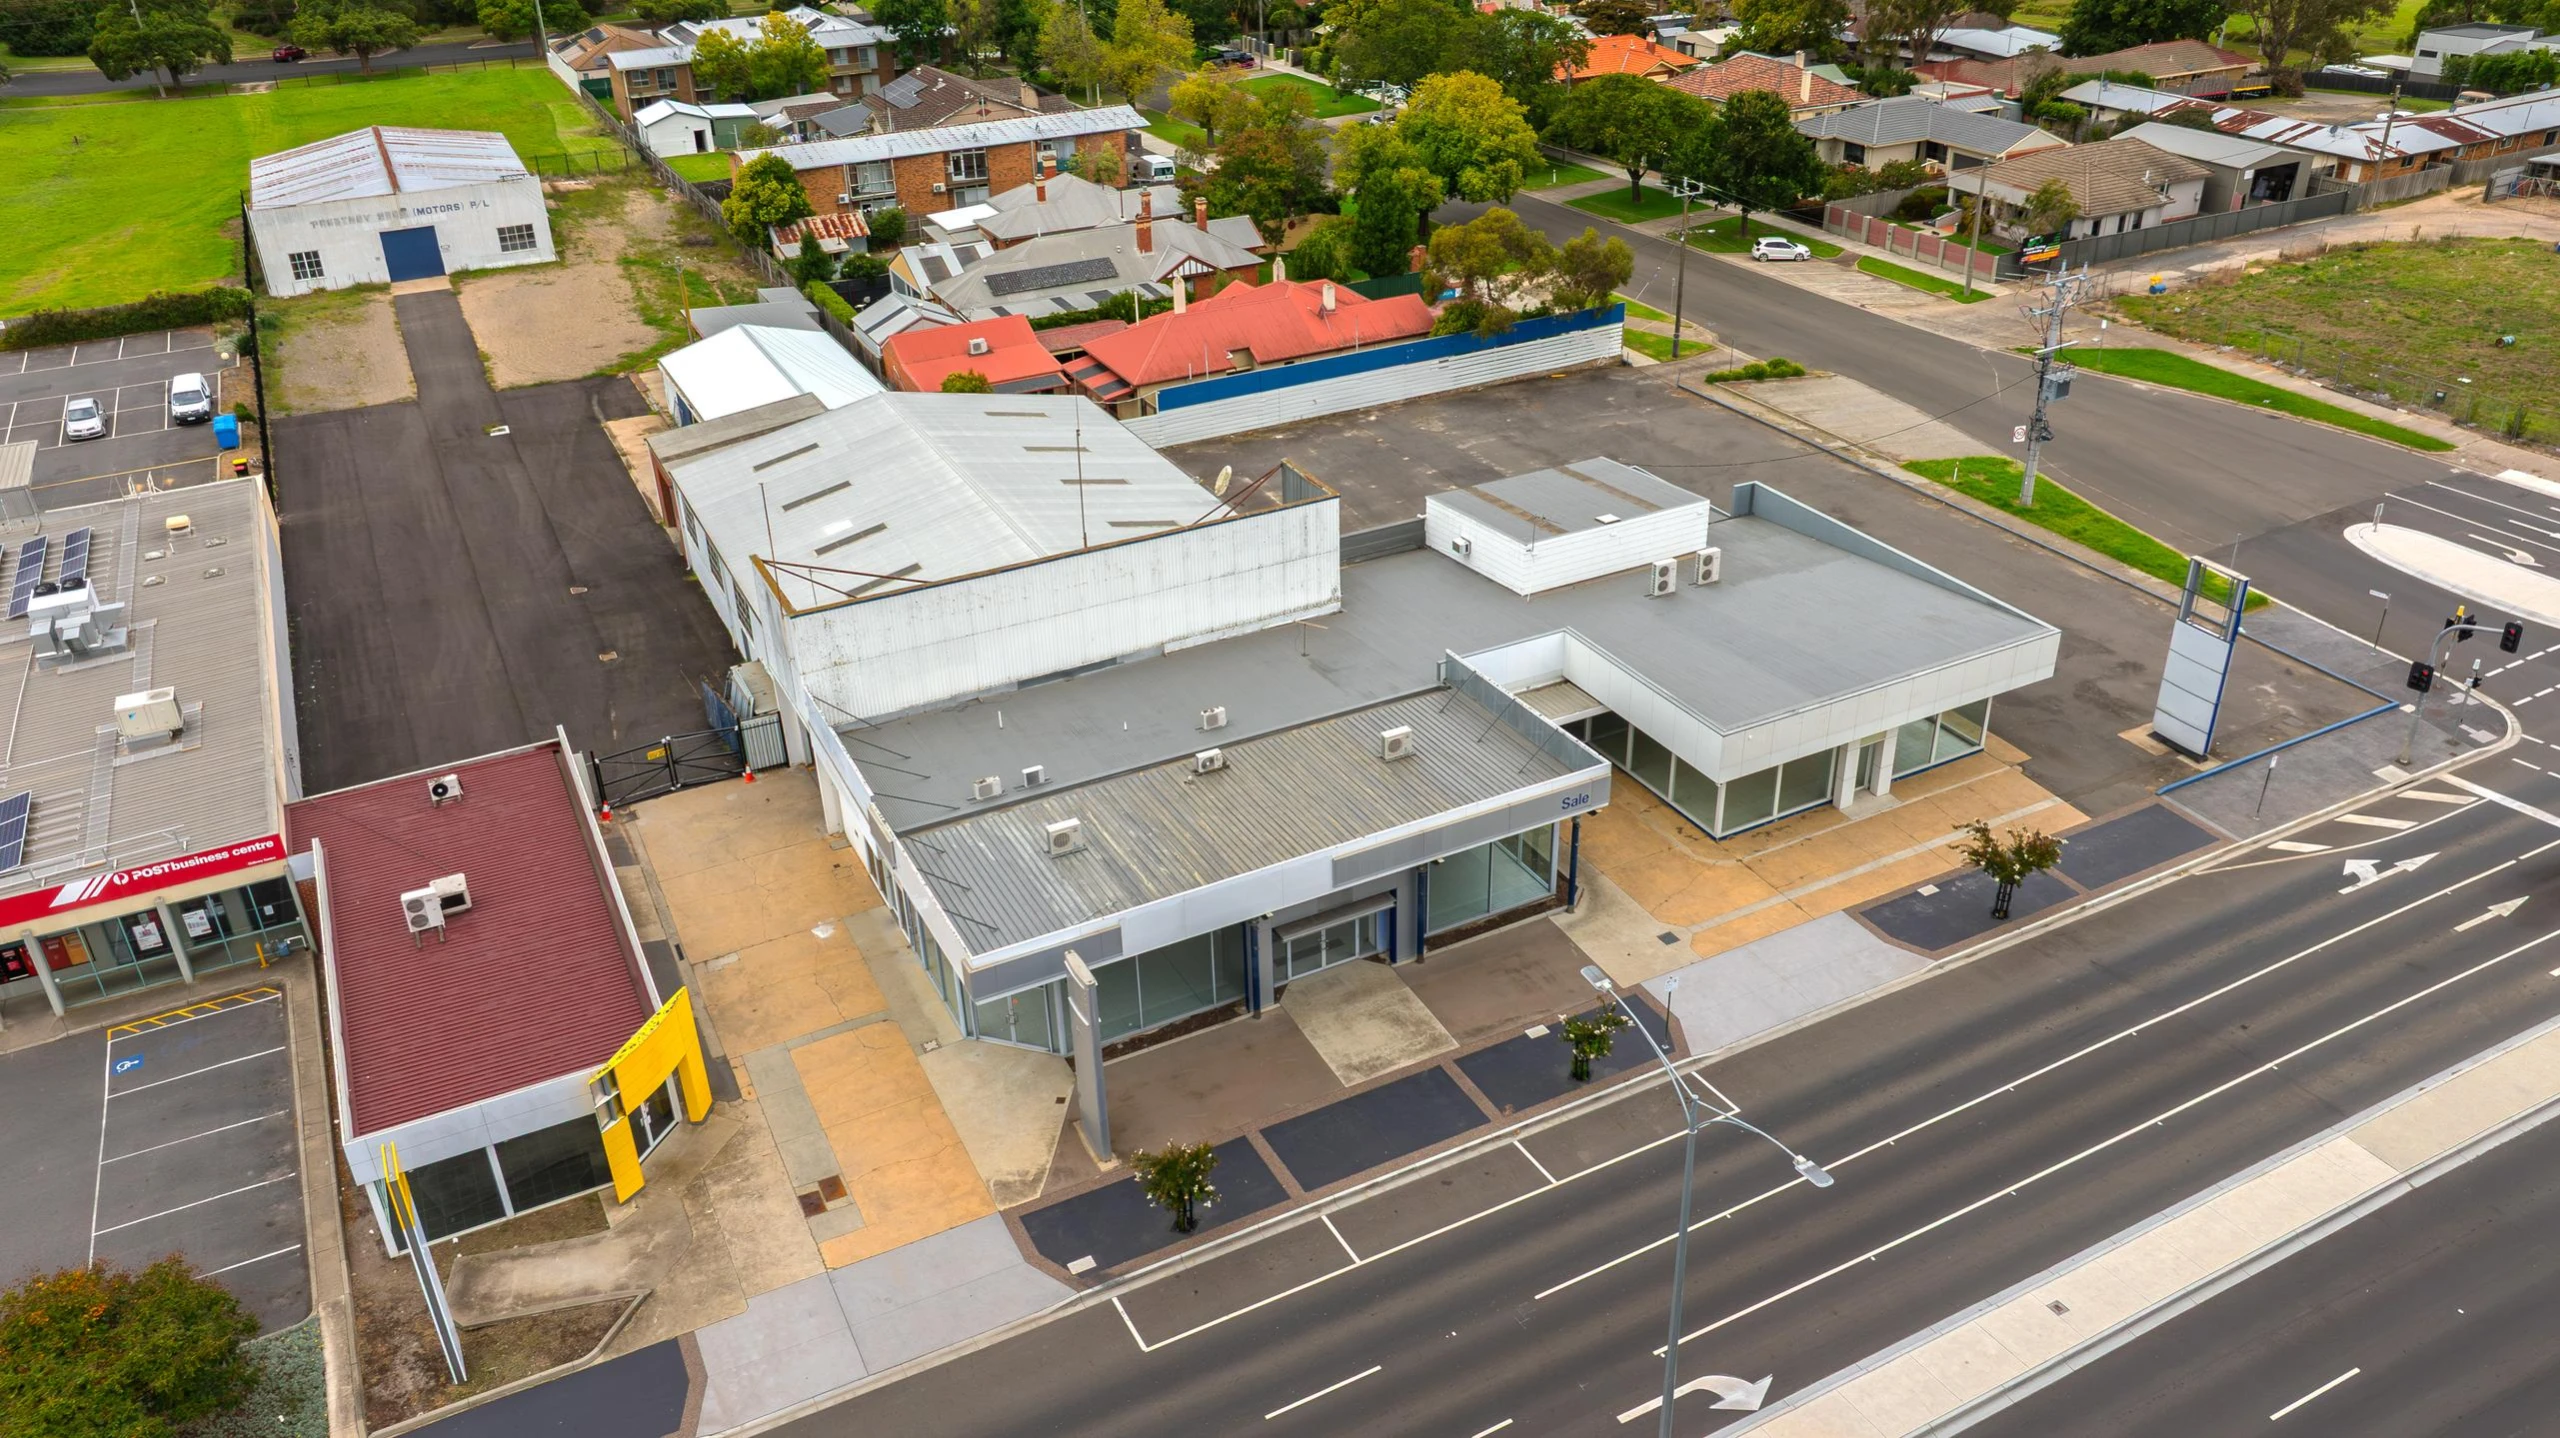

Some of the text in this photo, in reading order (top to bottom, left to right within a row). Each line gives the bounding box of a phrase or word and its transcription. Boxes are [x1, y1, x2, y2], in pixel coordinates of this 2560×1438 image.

[412, 202, 465, 217] (MOTORS)
[1561, 793, 1589, 810] Sale
[232, 840, 274, 857] centre
